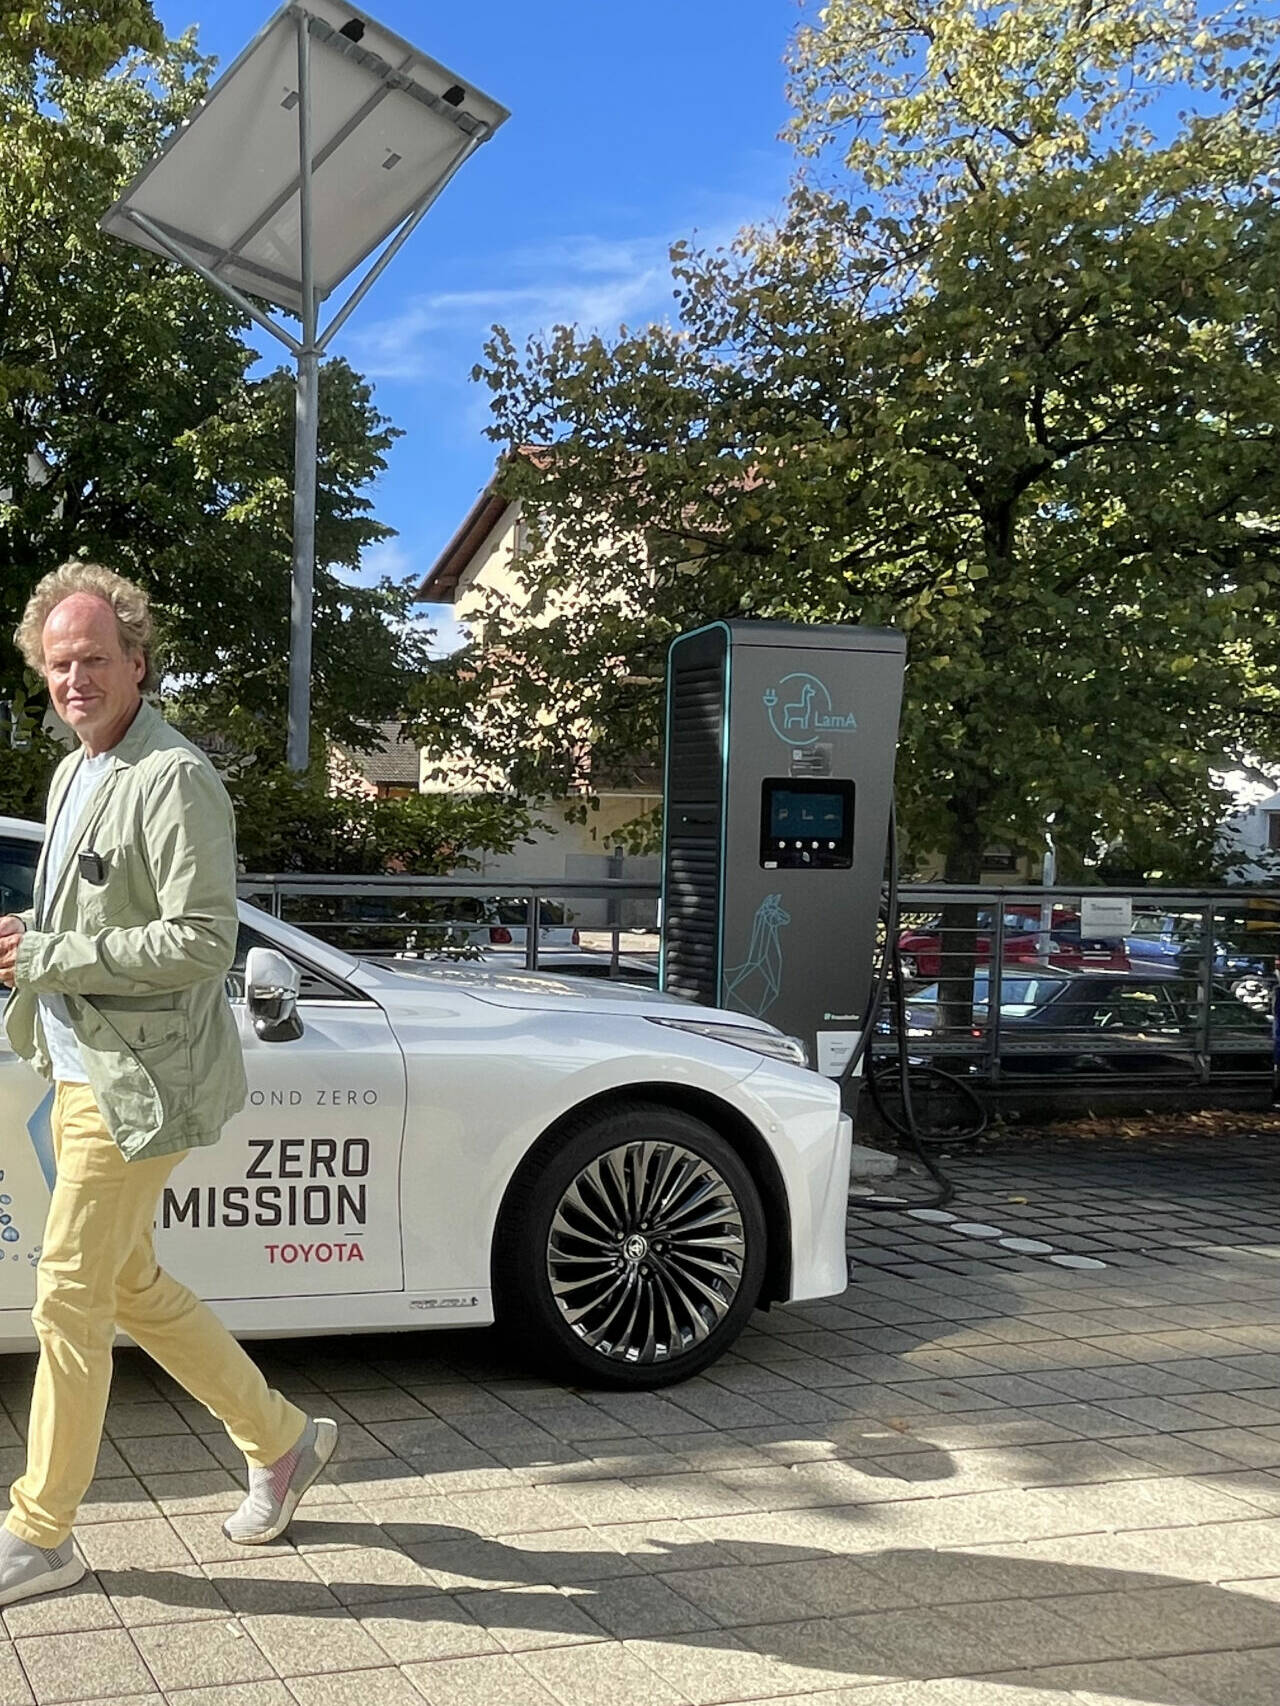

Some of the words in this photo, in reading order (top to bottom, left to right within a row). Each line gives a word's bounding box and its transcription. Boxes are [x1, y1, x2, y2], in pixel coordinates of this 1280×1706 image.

[815, 711, 857, 728] LamA
[250, 1090, 302, 1106] OND
[316, 1089, 378, 1106] ZERO
[246, 1138, 370, 1179] ZERO
[153, 1184, 367, 1230] MISSION
[264, 1242, 365, 1264] TOYOTA
